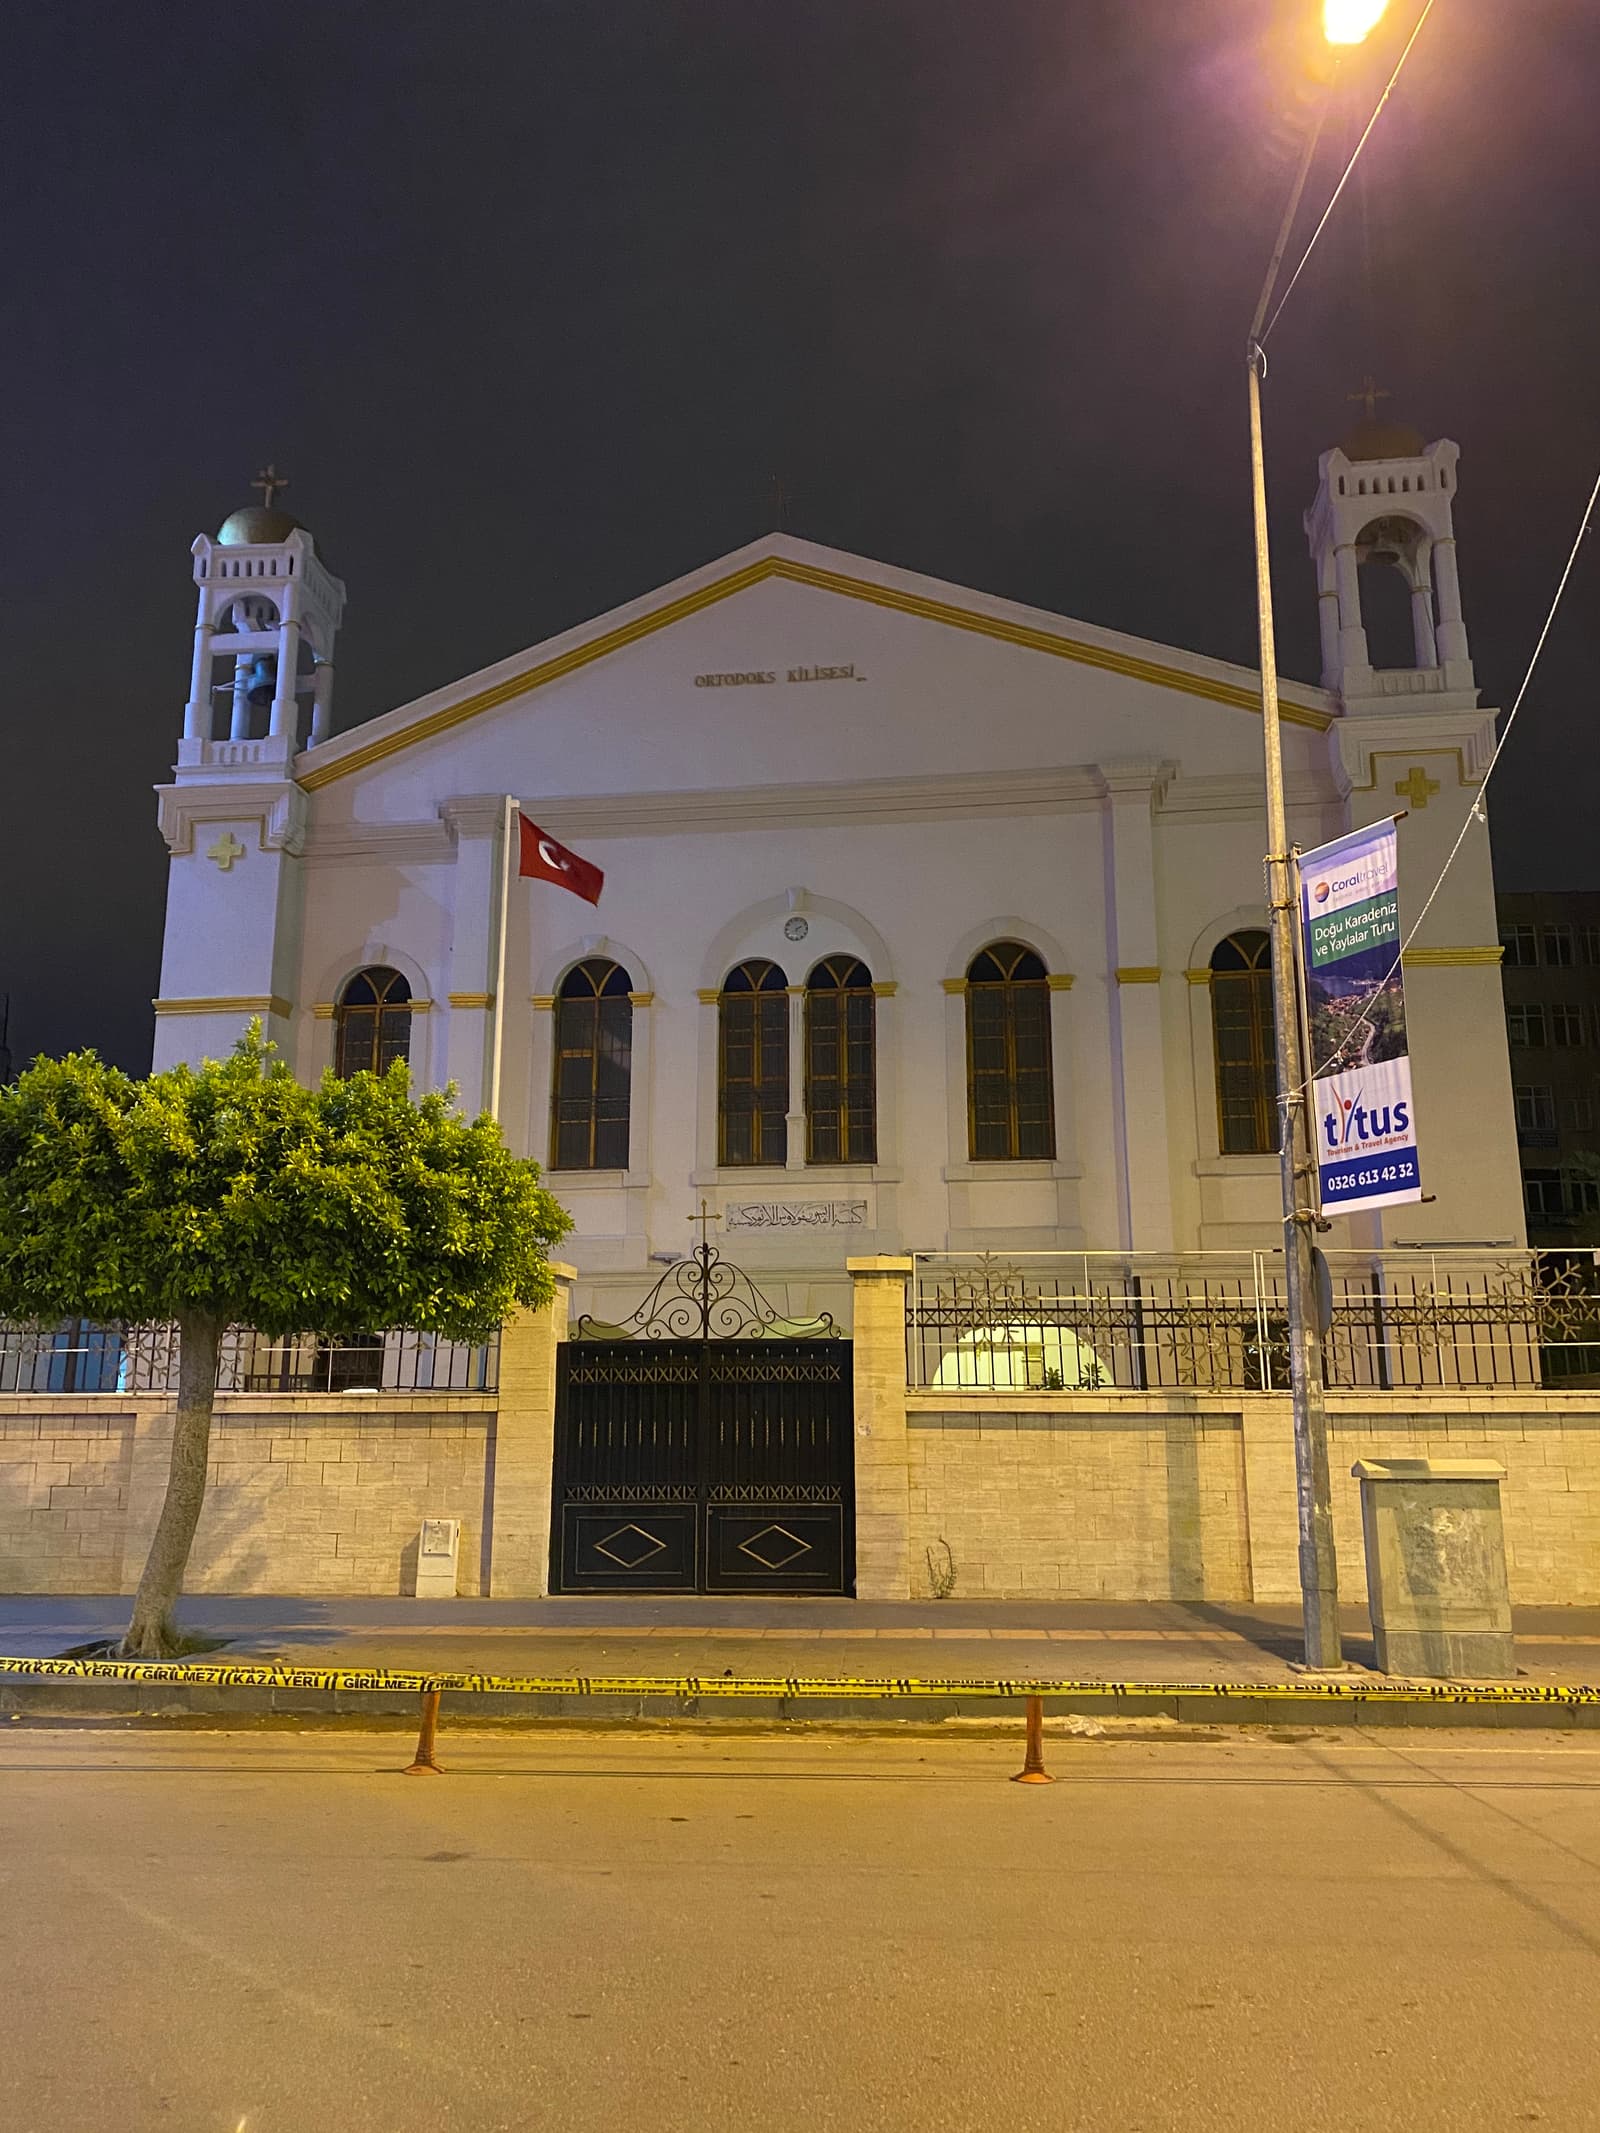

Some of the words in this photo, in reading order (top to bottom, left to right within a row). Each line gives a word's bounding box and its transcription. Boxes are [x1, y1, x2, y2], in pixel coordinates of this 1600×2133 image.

[695, 671, 776, 688] ORTODOKS
[1315, 921, 1342, 941] Doğu
[1345, 902, 1397, 929] Karadeniz
[1315, 945, 1328, 957] ve
[1329, 928, 1369, 953] Yaylalar
[1370, 921, 1395, 937] Turu
[1327, 1146, 1352, 1156] Tourism
[1361, 1138, 1383, 1149] Travel
[1384, 1133, 1409, 1146] Agency
[1327, 1174, 1356, 1191] 0326
[1358, 1169, 1379, 1185] 613
[1381, 1166, 1396, 1180] 42
[1398, 1162, 1414, 1177] 32
[233, 1673, 278, 1685] KAZA
